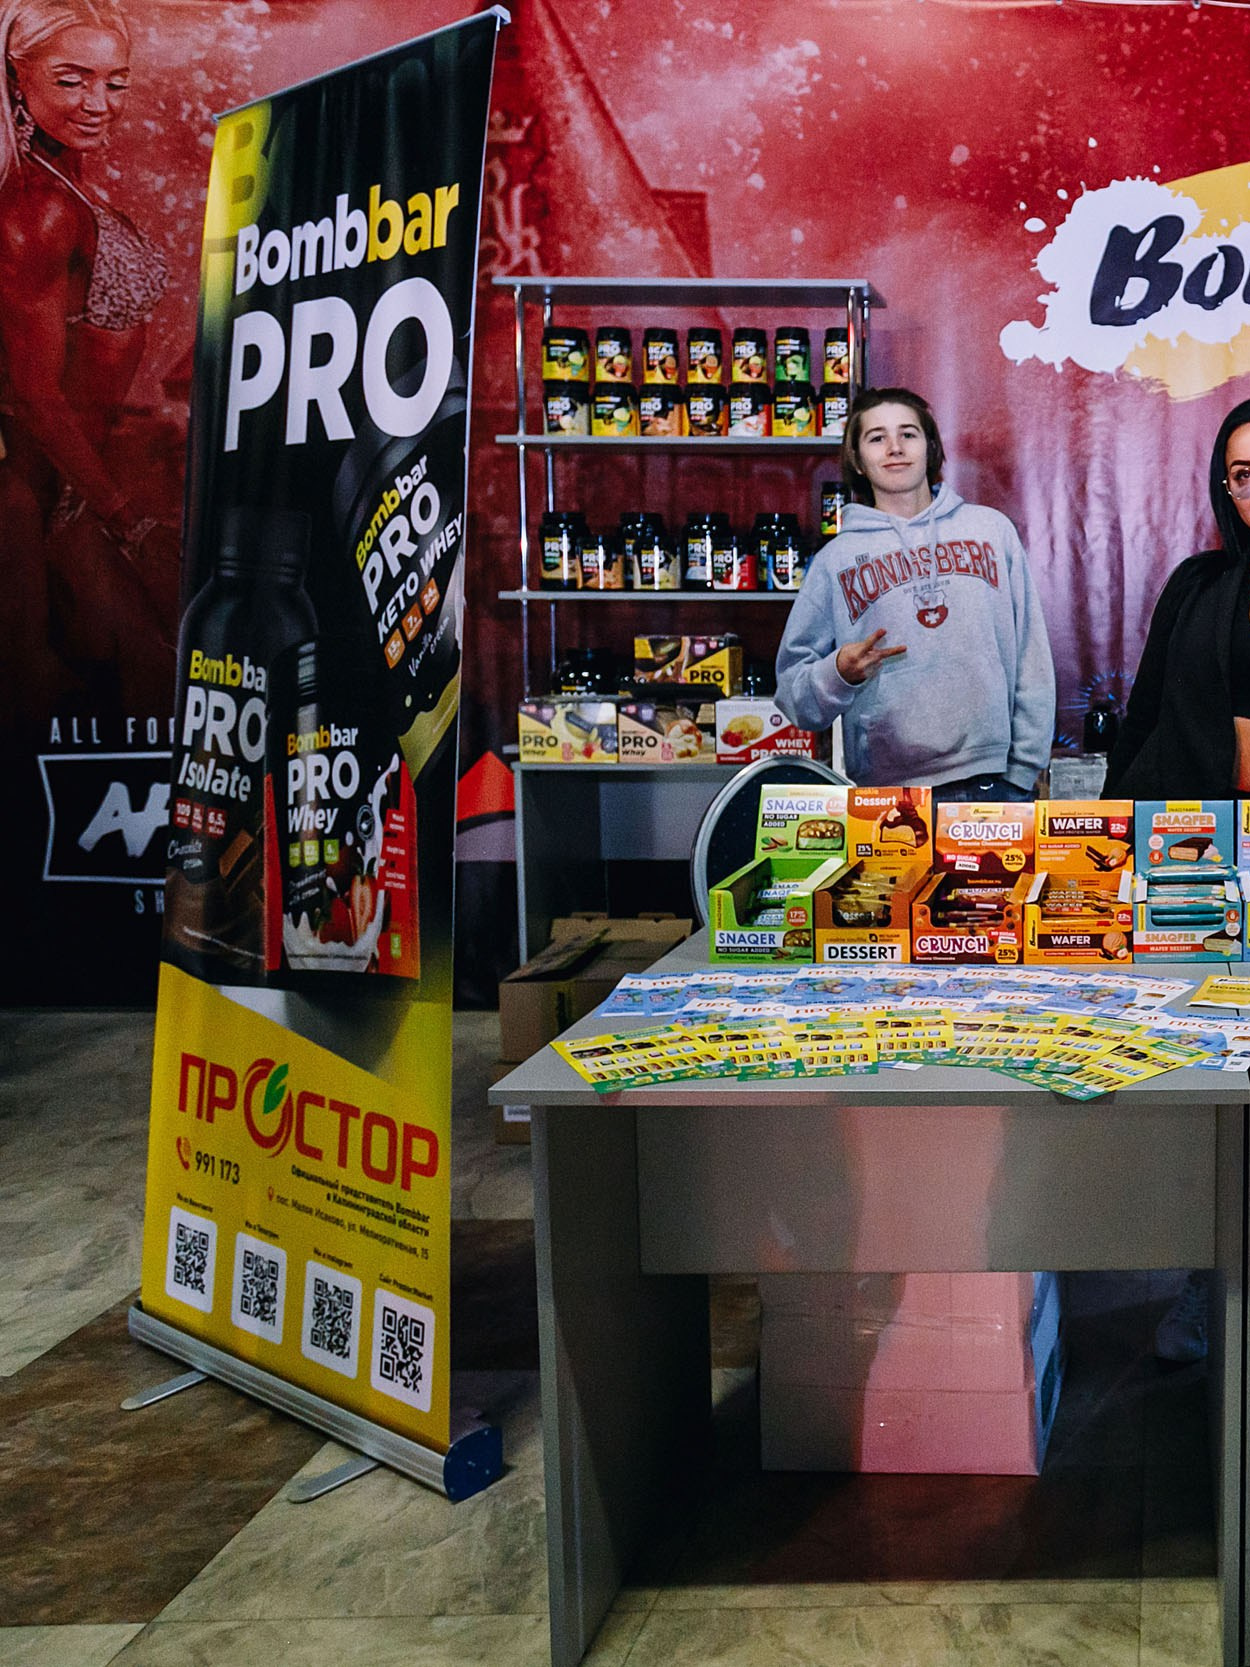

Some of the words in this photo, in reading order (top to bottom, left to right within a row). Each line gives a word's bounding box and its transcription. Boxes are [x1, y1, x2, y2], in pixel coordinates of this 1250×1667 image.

[235, 182, 460, 296] Bombbar
[224, 276, 454, 452] PRO
[355, 455, 428, 571] Bombbar
[362, 482, 440, 615] PRO
[377, 571, 420, 645] KETO
[419, 512, 463, 577] WHEY
[189, 650, 266, 692] Bombba
[690, 670, 725, 682] PRO
[50, 716, 101, 744] ALL
[182, 686, 269, 763] PRO
[287, 723, 359, 757] Bombbar
[522, 735, 559, 748] PRO
[621, 735, 658, 748] PRO
[775, 738, 811, 749] WHEY
[177, 752, 251, 802] Isolate
[287, 750, 360, 806] PRO
[766, 799, 823, 812] SNAQER
[854, 795, 897, 807] Dessert
[288, 803, 339, 834] Whey
[1052, 818, 1103, 829] WAFER
[1154, 814, 1214, 826] SNAQFER
[951, 822, 1021, 840] CRUNCH
[1004, 854, 1023, 862] 25%
[718, 932, 776, 945] SNAQER
[917, 937, 987, 953] CRUNCH
[1051, 935, 1091, 945] WAFER
[1145, 932, 1196, 942] SNAQFER
[827, 946, 897, 960] DESSERT
[998, 949, 1016, 957] 25%
[1094, 977, 1184, 991] ПРОСТОР
[178, 1052, 439, 1191] ПРОСТОР
[195, 1151, 215, 1176] 991
[220, 1158, 240, 1185] 173
